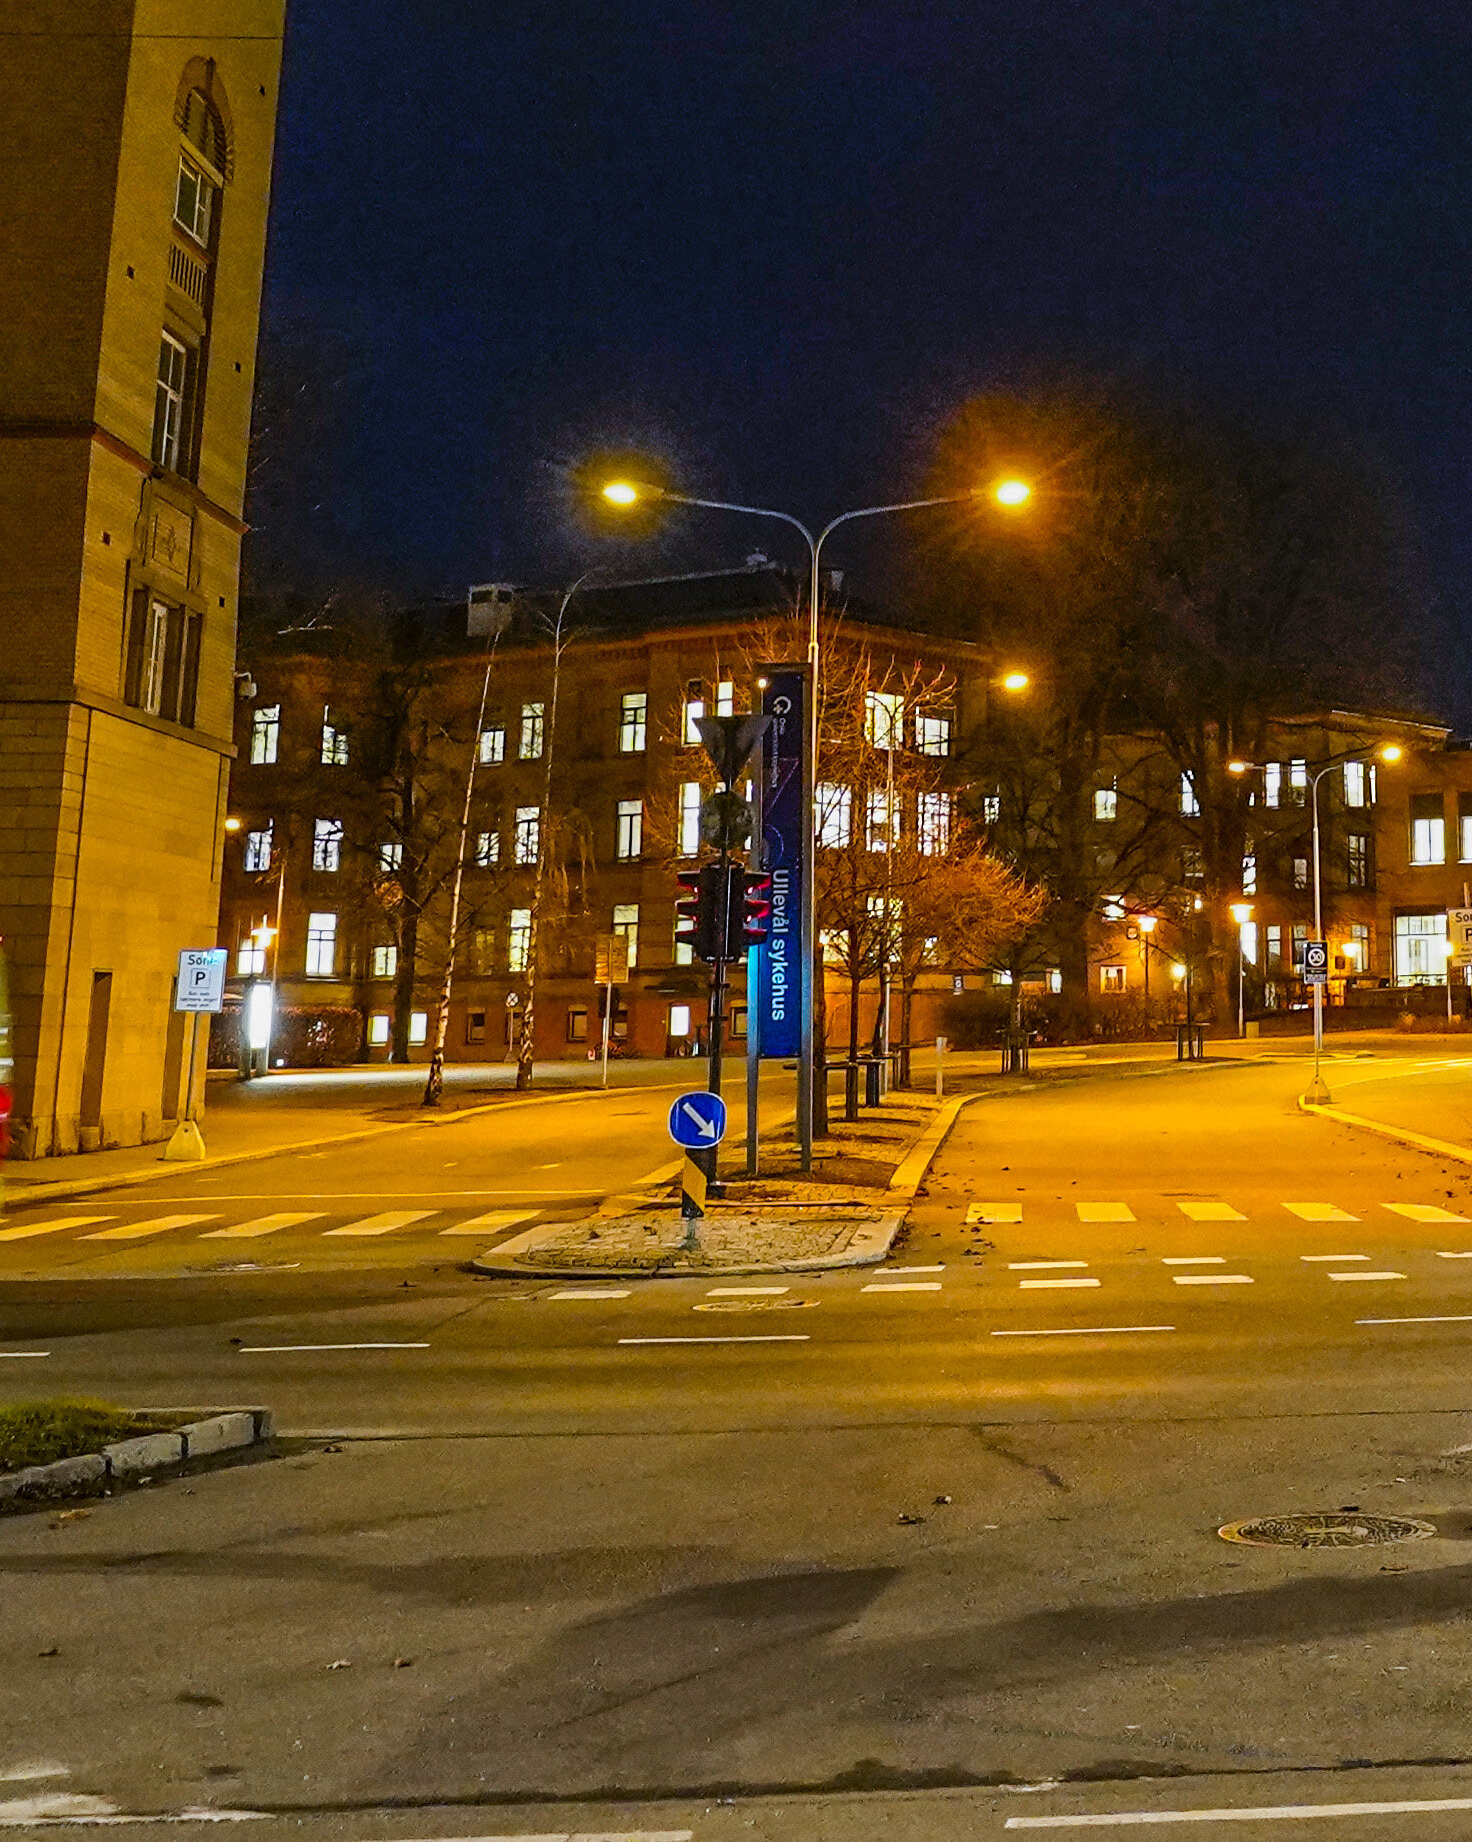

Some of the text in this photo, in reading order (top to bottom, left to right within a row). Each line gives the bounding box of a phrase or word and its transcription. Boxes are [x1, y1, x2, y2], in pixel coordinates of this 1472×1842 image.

[195, 971, 206, 985] P
[768, 869, 790, 1022] Ullevål sykehus
